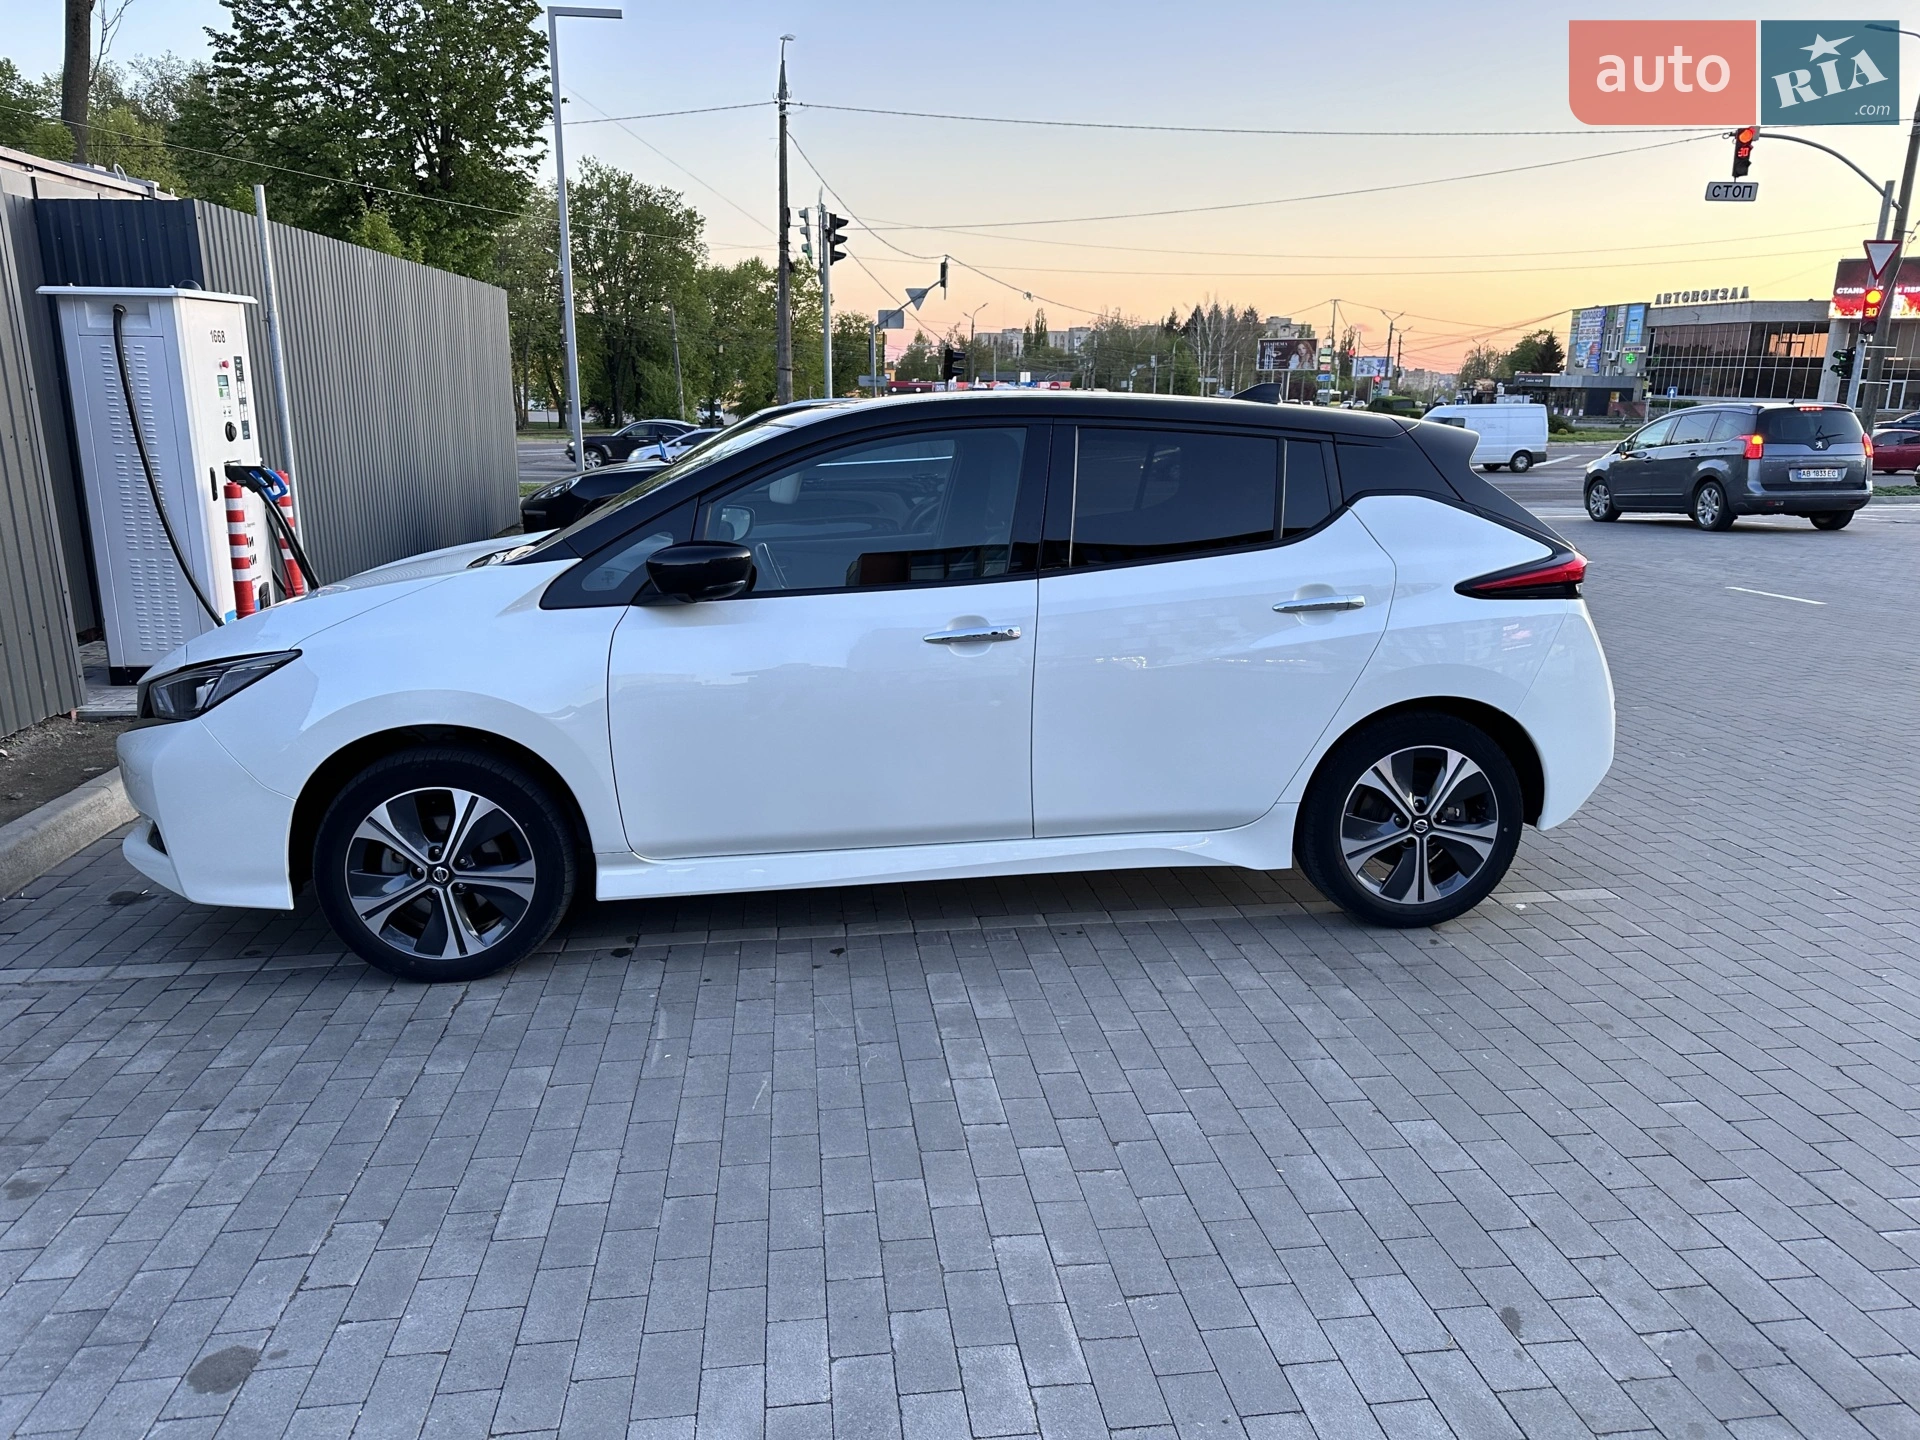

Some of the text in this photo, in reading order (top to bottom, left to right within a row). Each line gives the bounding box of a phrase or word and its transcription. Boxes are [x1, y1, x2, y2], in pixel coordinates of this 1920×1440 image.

[1712, 185, 1753, 198] СТОП
[1655, 286, 1749, 305] АВТОВОКЗАЛ
[1865, 307, 1878, 317] 30
[210, 330, 226, 343] 1668
